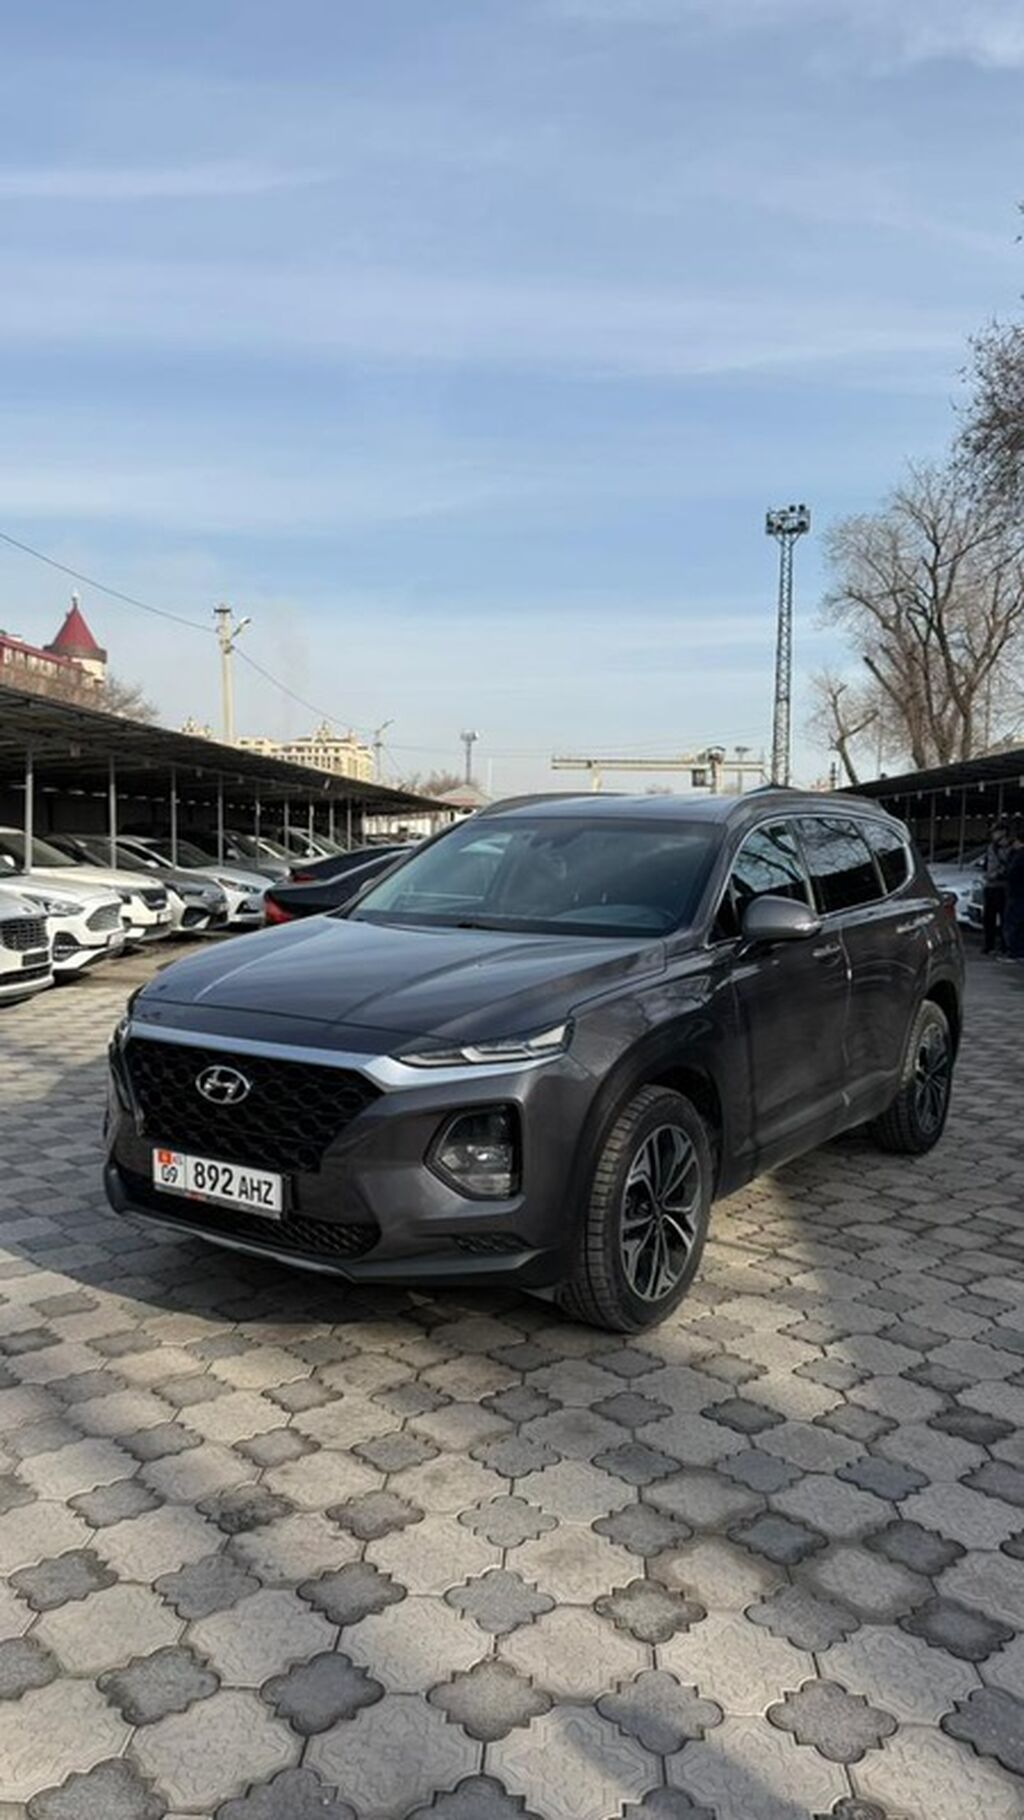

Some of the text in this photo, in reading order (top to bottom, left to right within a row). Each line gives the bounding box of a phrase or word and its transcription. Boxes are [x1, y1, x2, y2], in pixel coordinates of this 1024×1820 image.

[161, 1165, 178, 1183] 09
[194, 1161, 234, 1196] 892
[238, 1175, 274, 1206] AHZ
